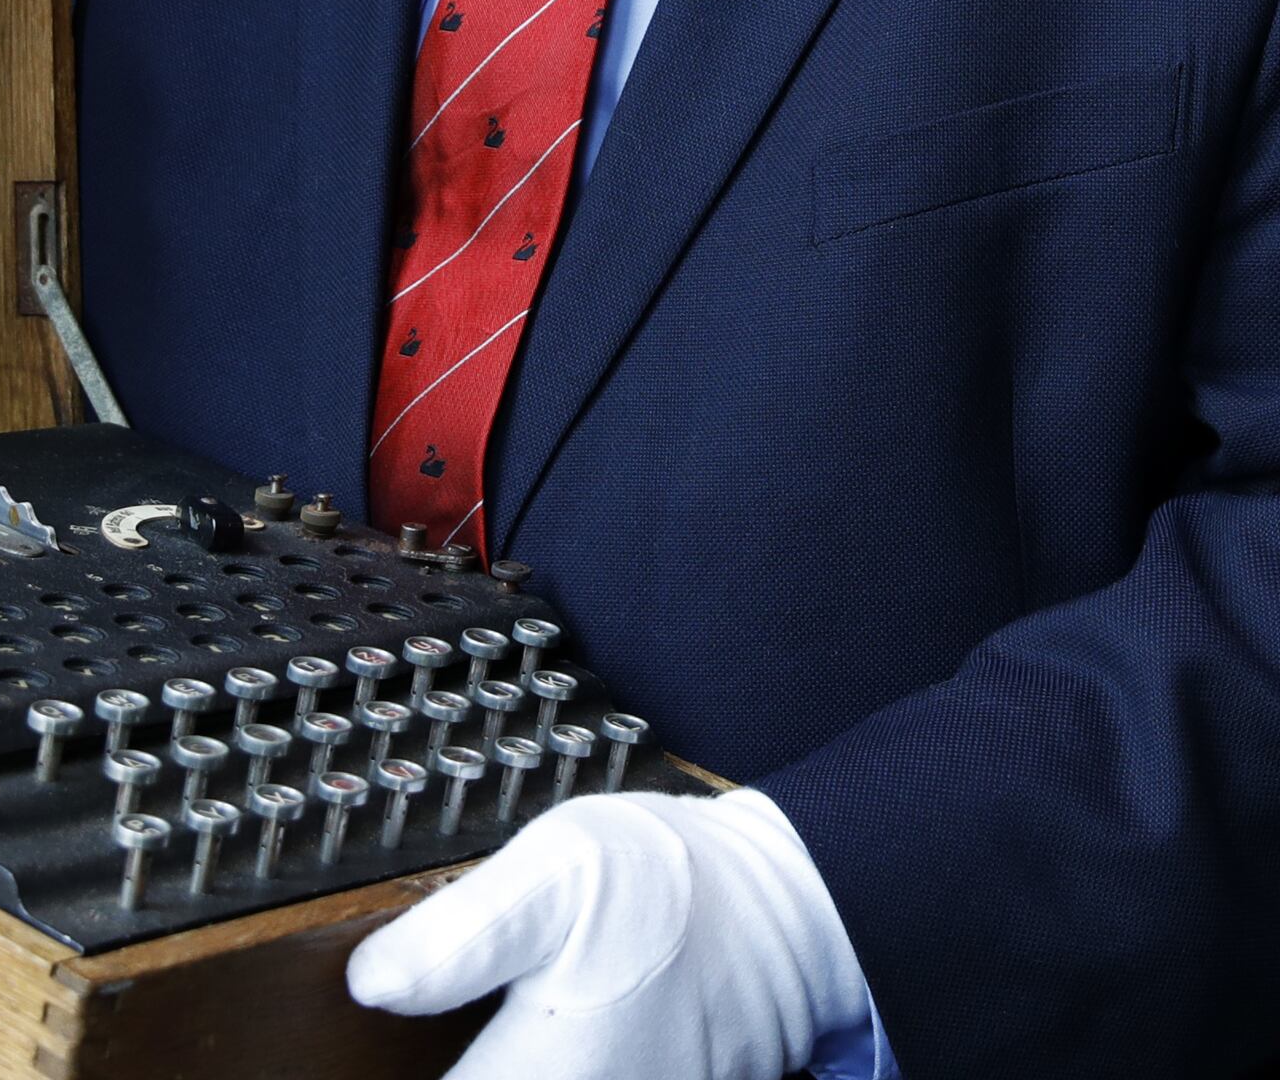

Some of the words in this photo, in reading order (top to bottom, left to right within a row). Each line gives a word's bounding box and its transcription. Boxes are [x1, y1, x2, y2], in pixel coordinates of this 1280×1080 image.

[123, 757, 151, 768] A
[539, 676, 569, 687] K
[198, 806, 225, 819] Y
[263, 791, 298, 804] X
